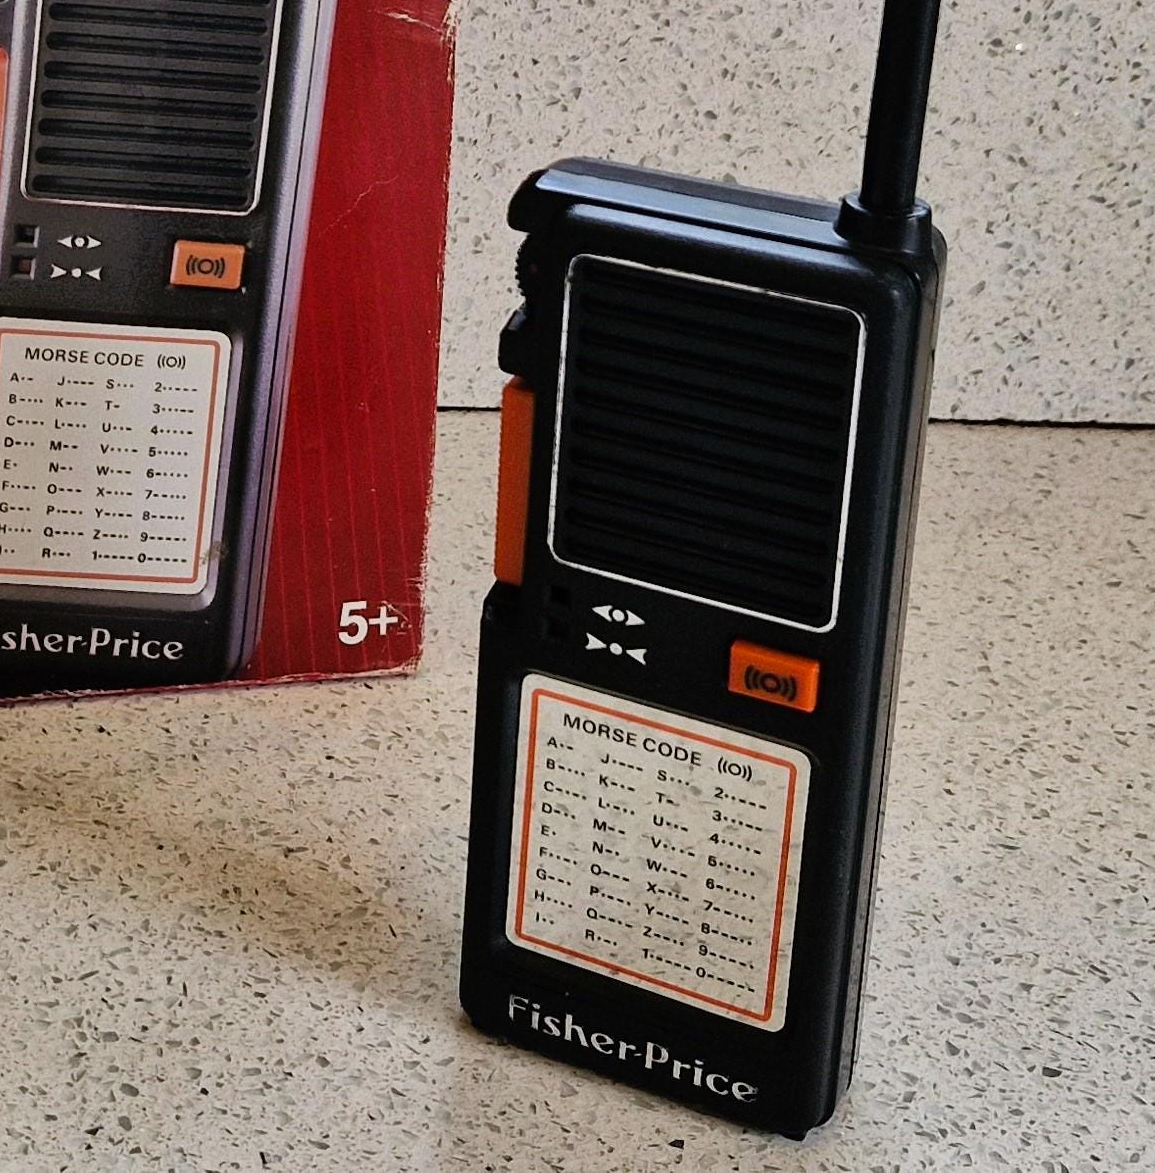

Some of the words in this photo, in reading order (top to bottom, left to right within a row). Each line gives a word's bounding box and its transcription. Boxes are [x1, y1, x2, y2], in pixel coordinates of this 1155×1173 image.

[24, 347, 89, 364] MORSE
[94, 352, 145, 367] CODE
[338, 600, 399, 645] 5+
[563, 713, 638, 748] MORSE
[643, 737, 703, 767] CODE
[508, 993, 759, 1103] Fisher-Price
